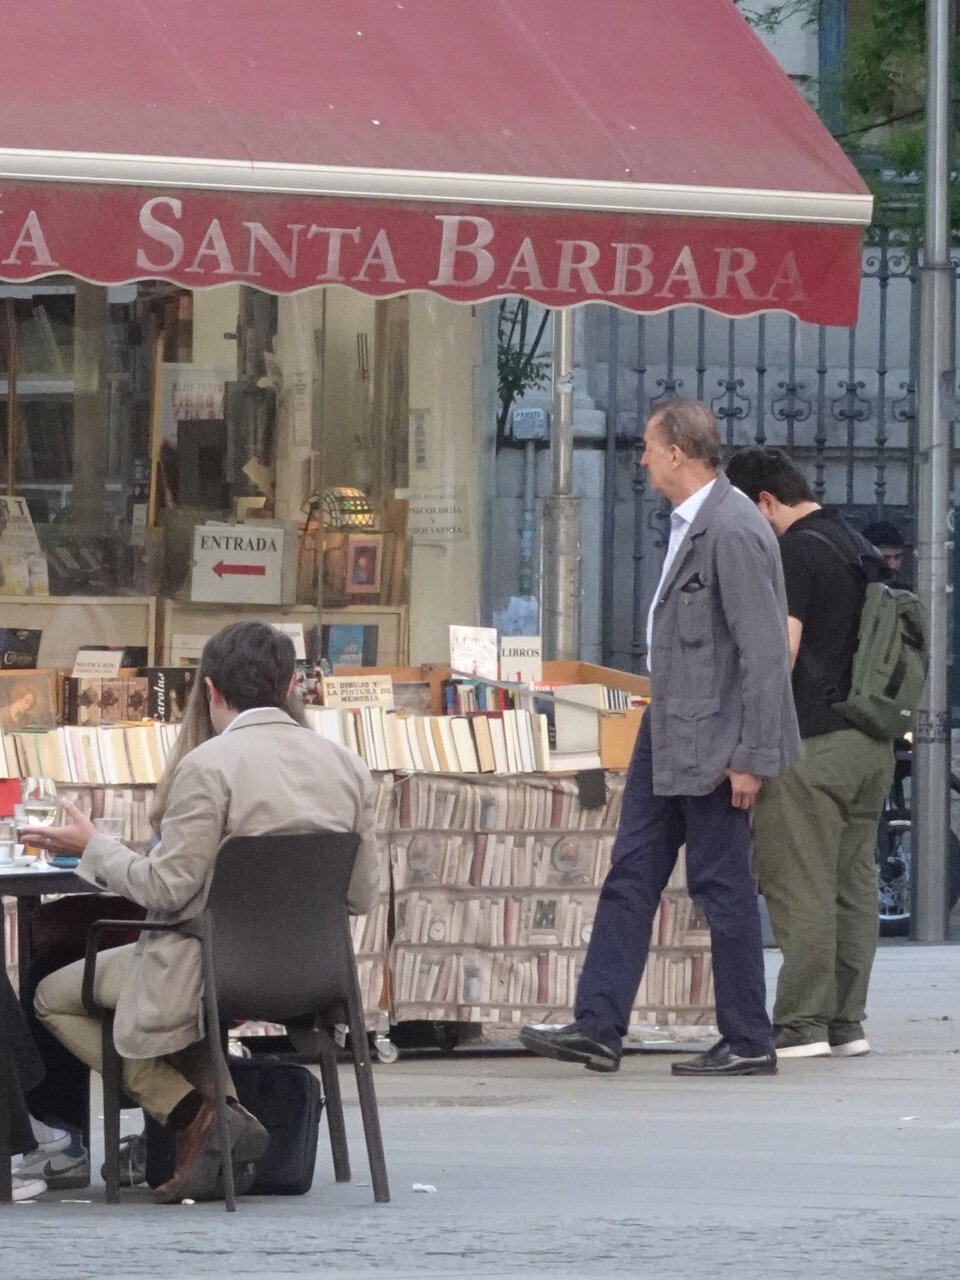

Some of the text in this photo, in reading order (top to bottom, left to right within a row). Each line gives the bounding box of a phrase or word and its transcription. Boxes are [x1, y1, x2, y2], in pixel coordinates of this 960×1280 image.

[136, 195, 406, 284] SANTA
[428, 214, 810, 304] BARBARA
[200, 536, 278, 552] ENTRADA
[502, 648, 540, 657] LIBROS
